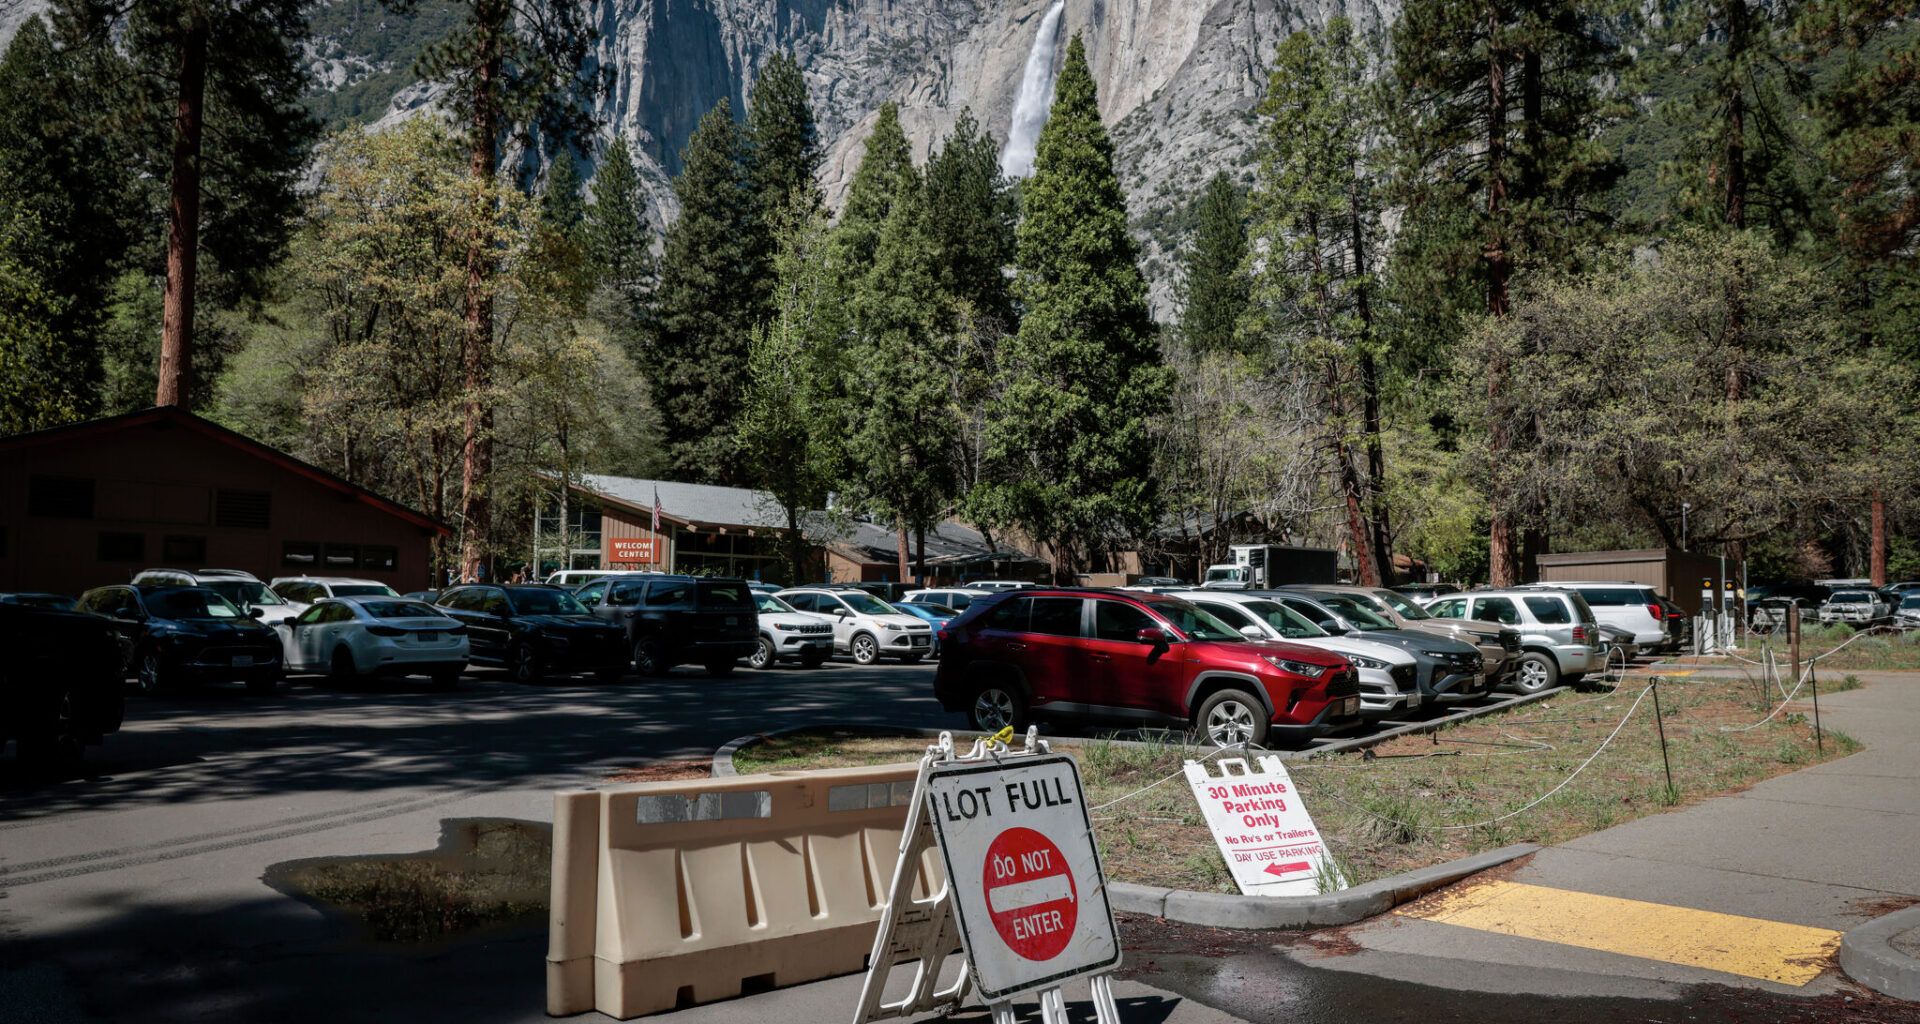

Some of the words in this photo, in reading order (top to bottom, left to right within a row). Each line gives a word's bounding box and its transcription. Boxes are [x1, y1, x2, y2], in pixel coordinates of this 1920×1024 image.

[943, 787, 992, 821] LOT
[1005, 777, 1072, 813] FULL
[1208, 786, 1229, 800] 30
[1232, 782, 1287, 798] Minute
[1223, 798, 1287, 813] Parking
[1243, 813, 1280, 828] Only
[1225, 835, 1239, 845] No
[1240, 833, 1262, 844] Rv's
[1264, 833, 1274, 842] or
[1275, 828, 1315, 841] Trailers
[1234, 852, 1252, 863] DAY
[1256, 850, 1278, 862] USE
[1279, 845, 1322, 858] PARKING
[993, 854, 1016, 879] DO
[1021, 849, 1051, 874] NOT
[1012, 910, 1064, 940] ENTER
